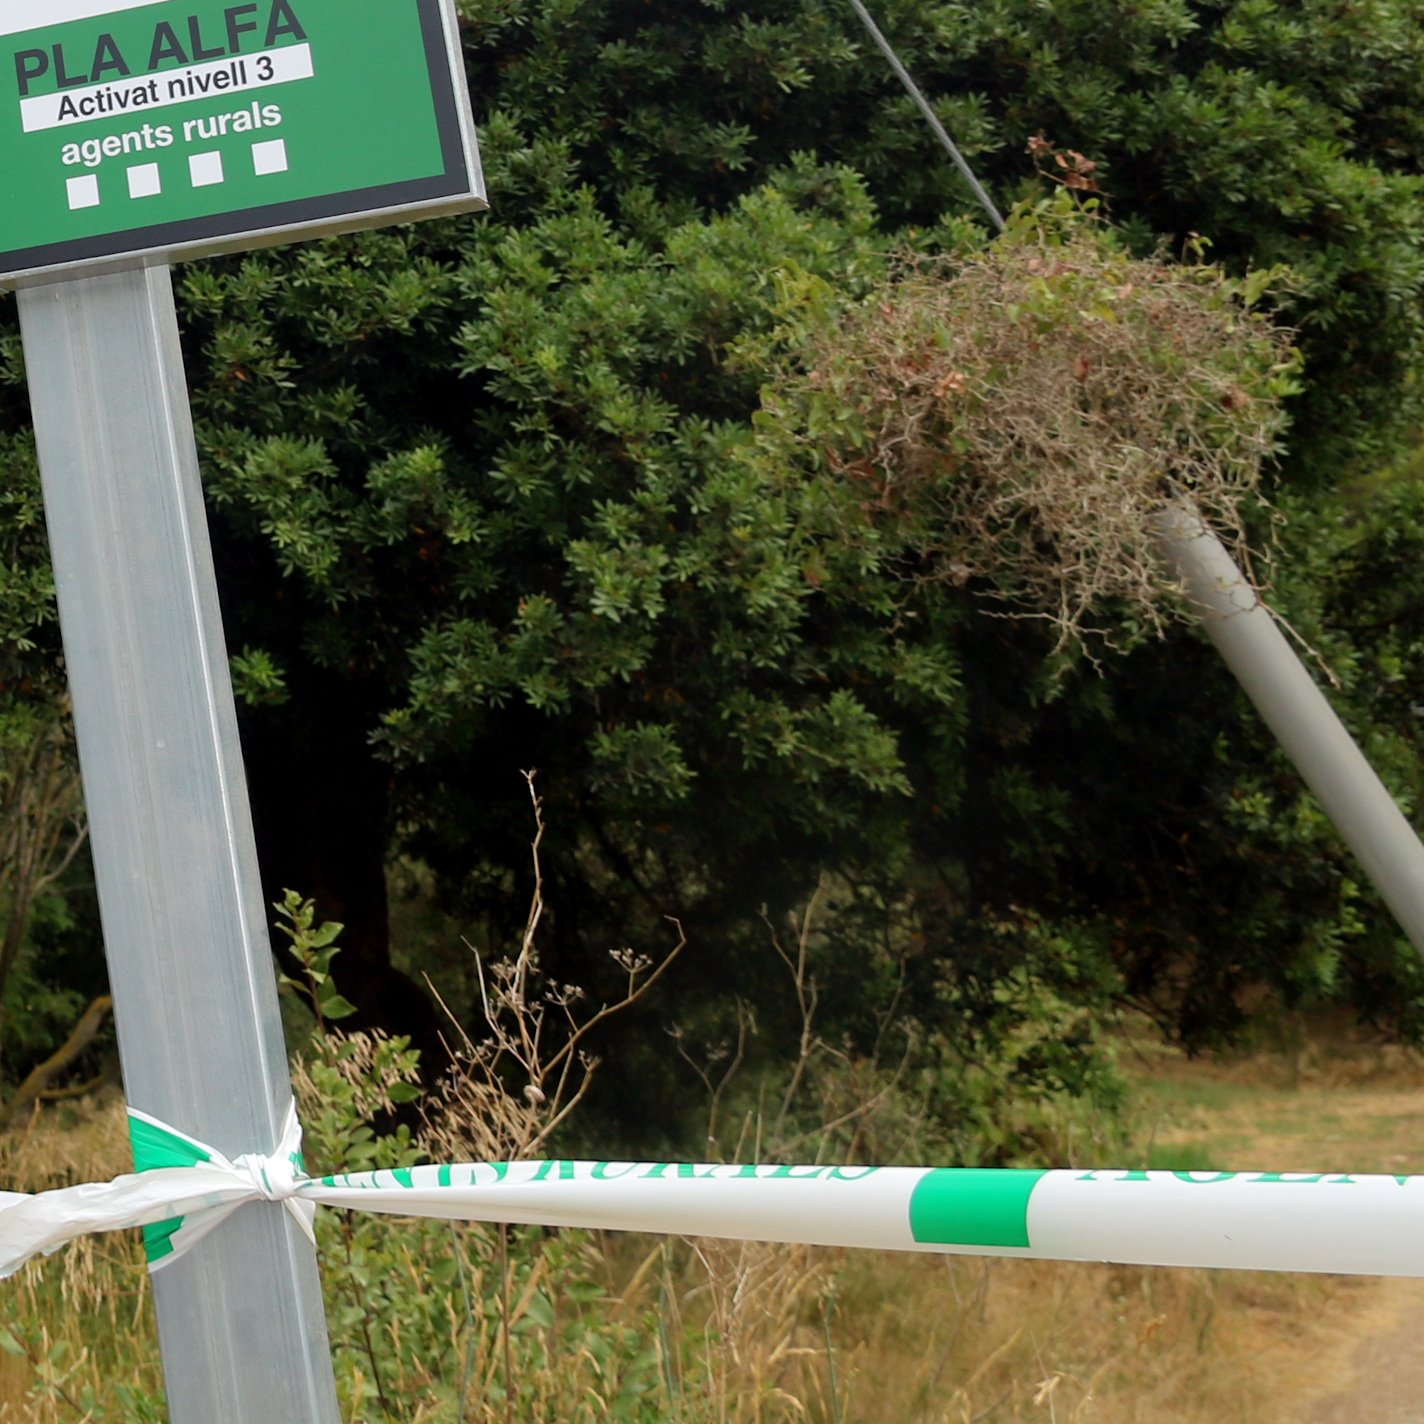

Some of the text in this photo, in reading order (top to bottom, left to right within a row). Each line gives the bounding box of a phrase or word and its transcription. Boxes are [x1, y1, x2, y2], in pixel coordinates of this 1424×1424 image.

[13, 32, 130, 96] PLA
[57, 55, 274, 121] Activat nivell 3
[61, 101, 282, 167] agents rurals
